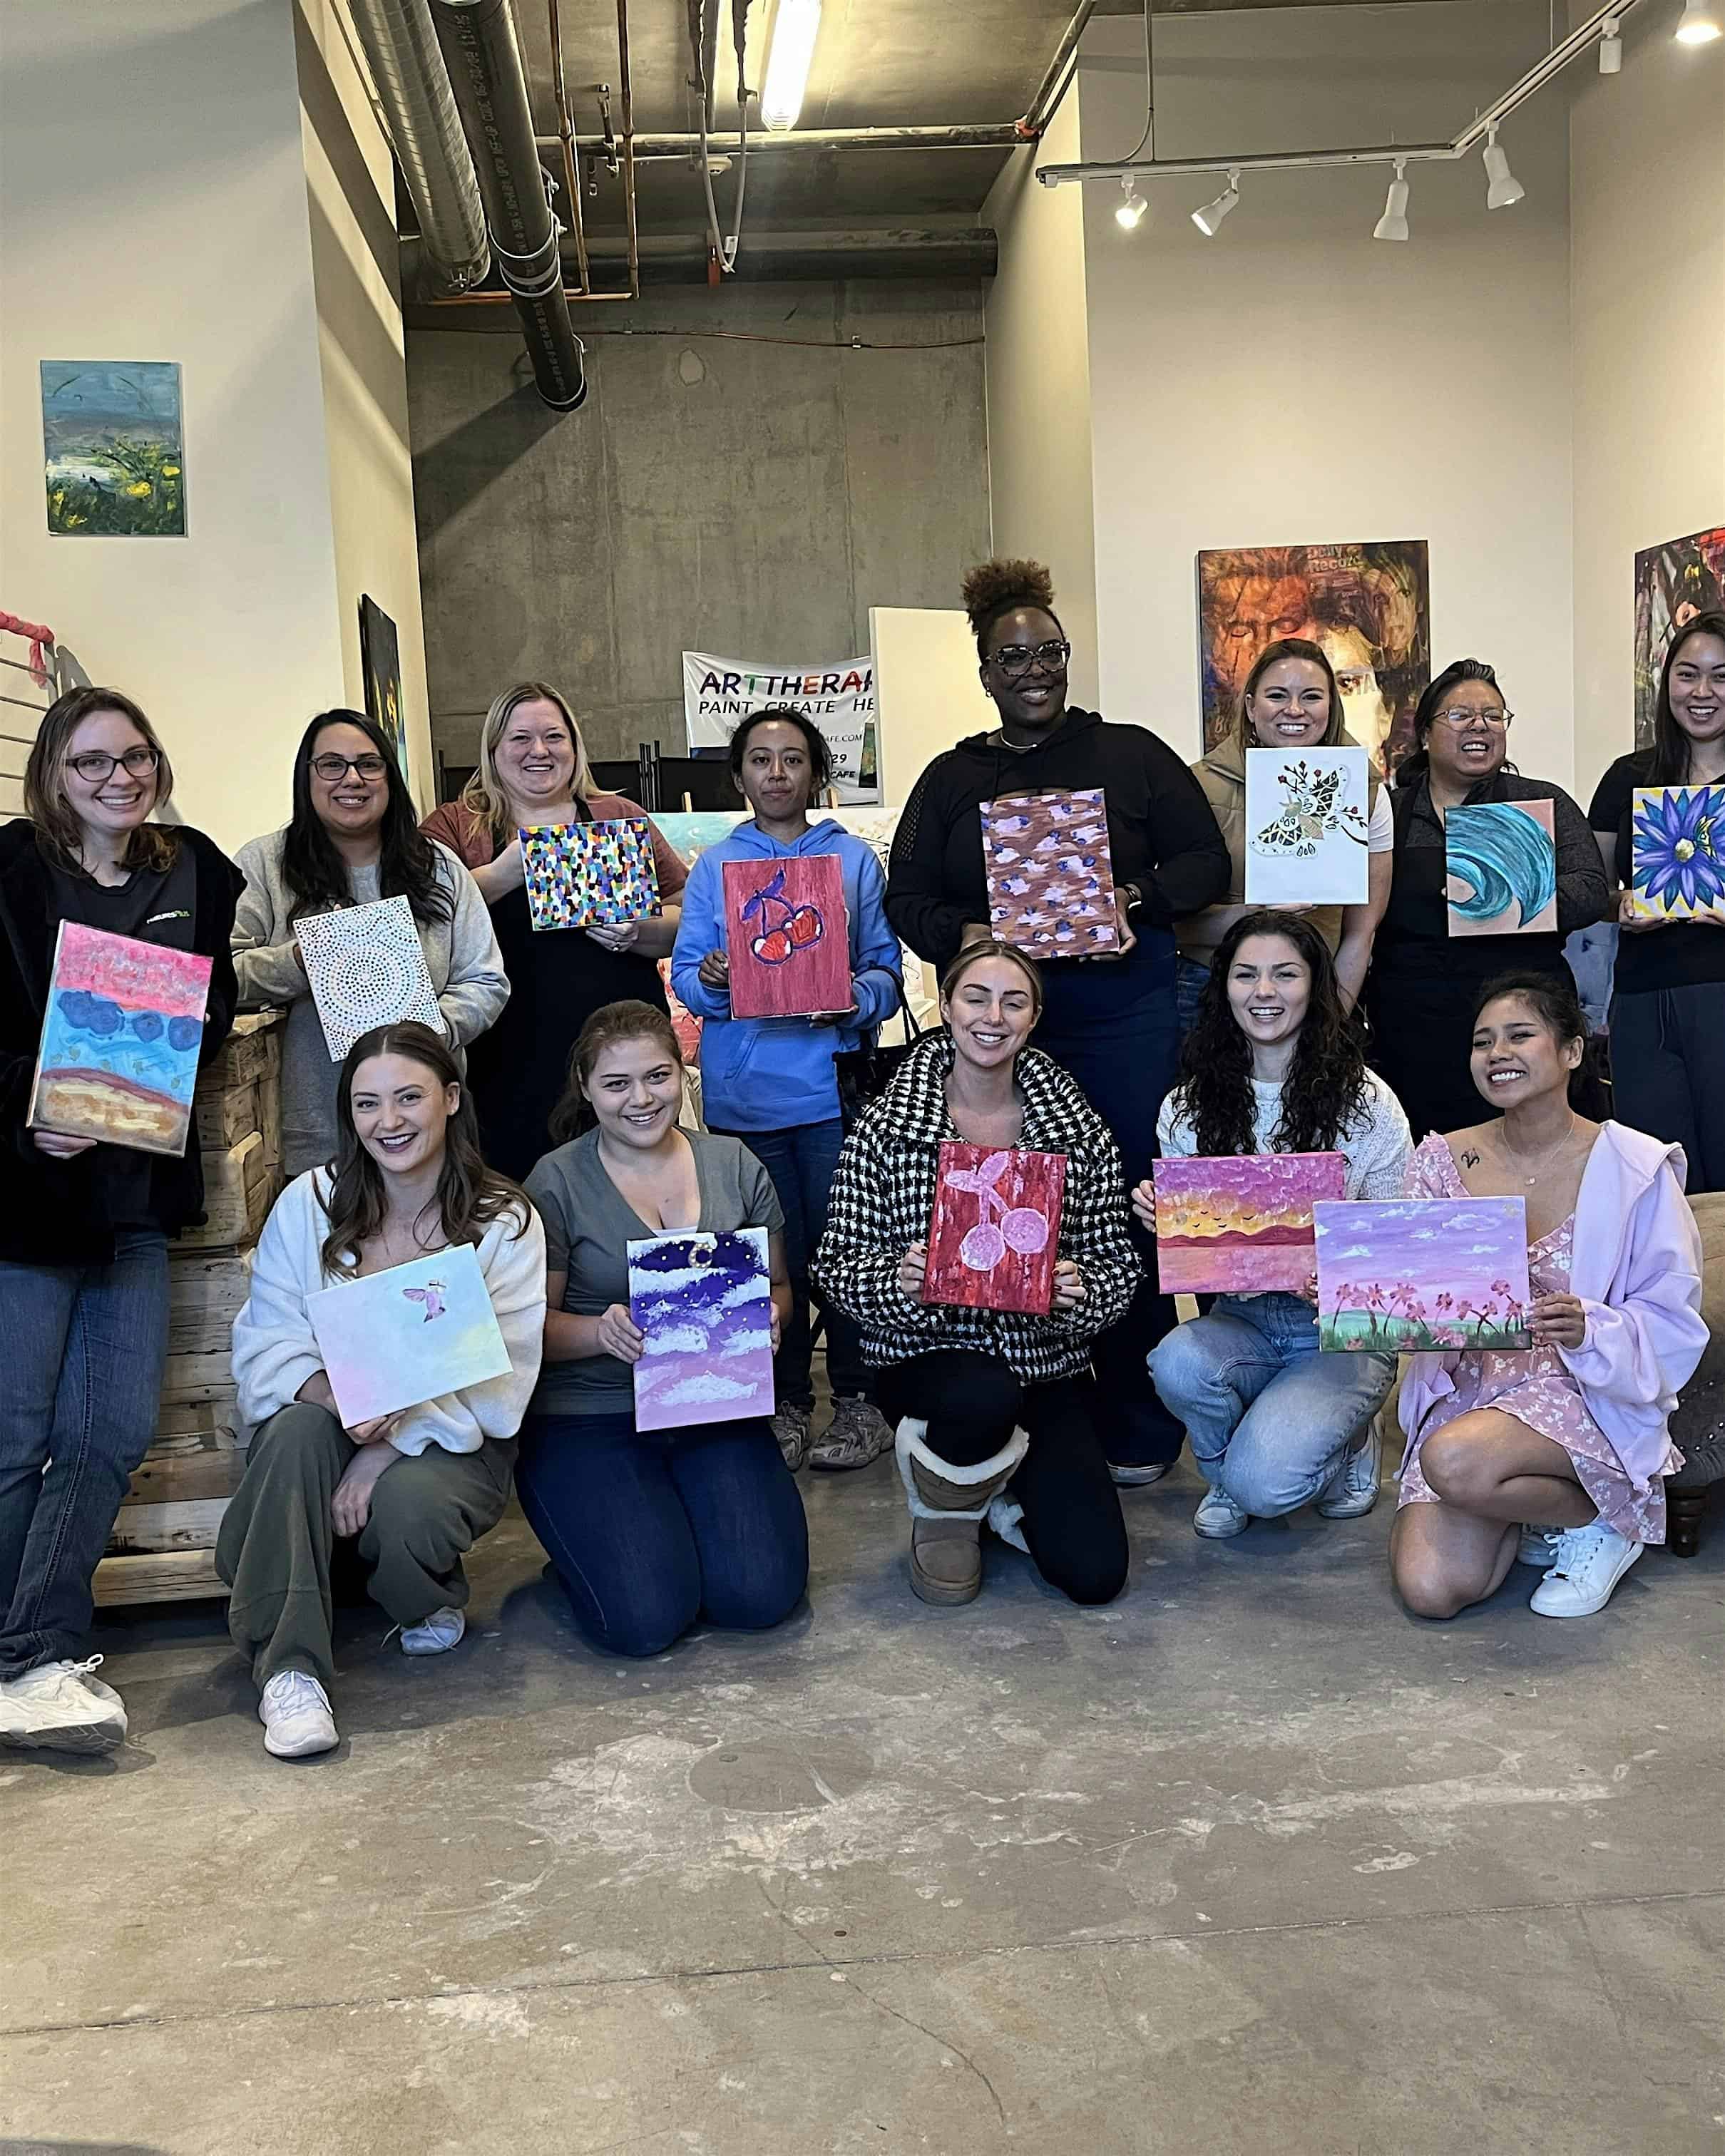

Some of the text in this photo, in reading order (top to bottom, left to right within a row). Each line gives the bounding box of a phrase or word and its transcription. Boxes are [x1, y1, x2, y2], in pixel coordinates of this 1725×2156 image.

[699, 701, 753, 714] PAINT
[765, 700, 836, 713] CREATE
[832, 754, 847, 764] 29
